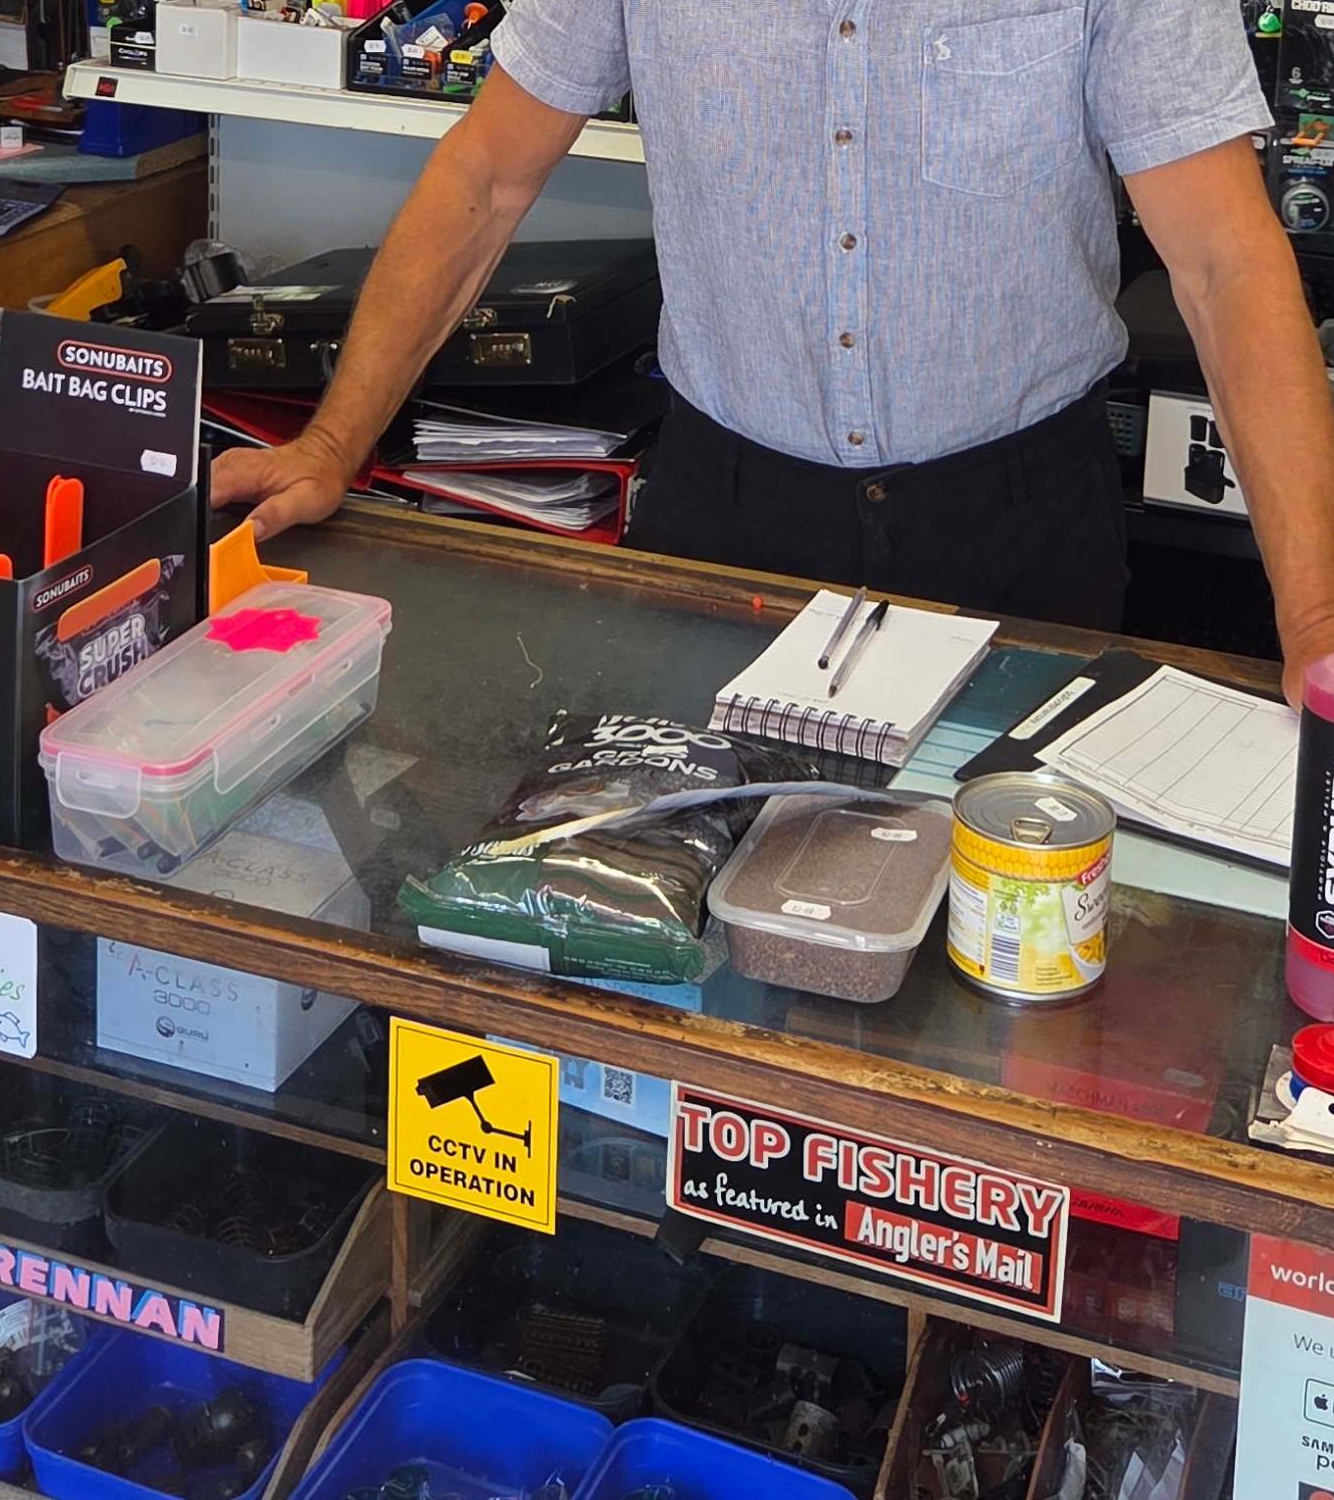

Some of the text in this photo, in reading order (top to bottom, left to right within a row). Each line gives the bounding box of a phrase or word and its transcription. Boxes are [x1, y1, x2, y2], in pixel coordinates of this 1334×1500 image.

[1291, 0, 1319, 13] CHOD
[65, 344, 163, 377] SONUBAITS
[22, 369, 167, 413] BAIT BAG CLIPS
[35, 565, 92, 607] SONUBAITS
[79, 615, 147, 671] SUPER
[77, 644, 149, 702] CRUSH
[586, 723, 732, 749] 3000
[548, 755, 719, 781] GARDONS
[427, 1134, 518, 1176] CCTV IN
[676, 1103, 1064, 1240] TOP FISHERY
[409, 1158, 536, 1208] OPERATION
[683, 1178, 838, 1231] as featured in
[857, 1208, 1036, 1292] Angler's Mail
[1293, 1333, 1323, 1356] We
